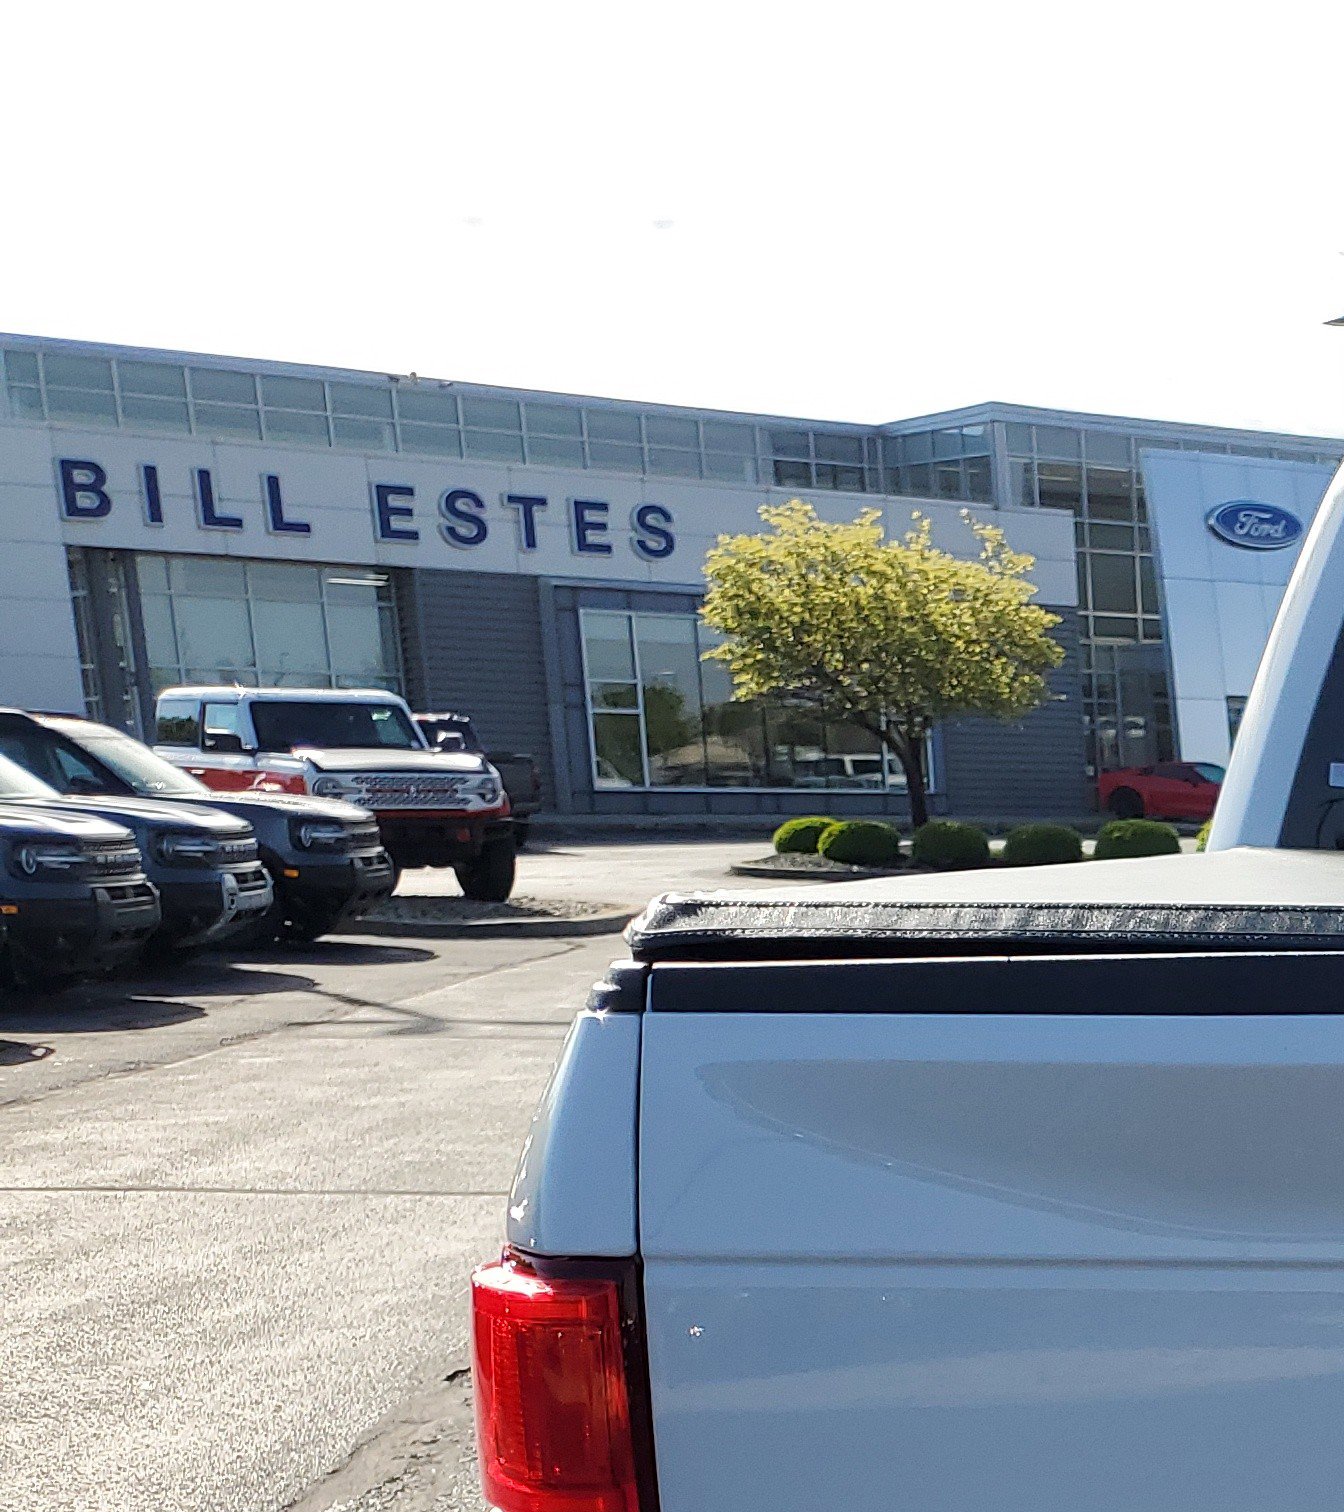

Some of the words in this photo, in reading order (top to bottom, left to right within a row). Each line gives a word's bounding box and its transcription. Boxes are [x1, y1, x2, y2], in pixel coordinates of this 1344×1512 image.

[57, 457, 311, 537] BILL
[373, 484, 676, 558] ESTES
[1234, 510, 1286, 538] Ford
